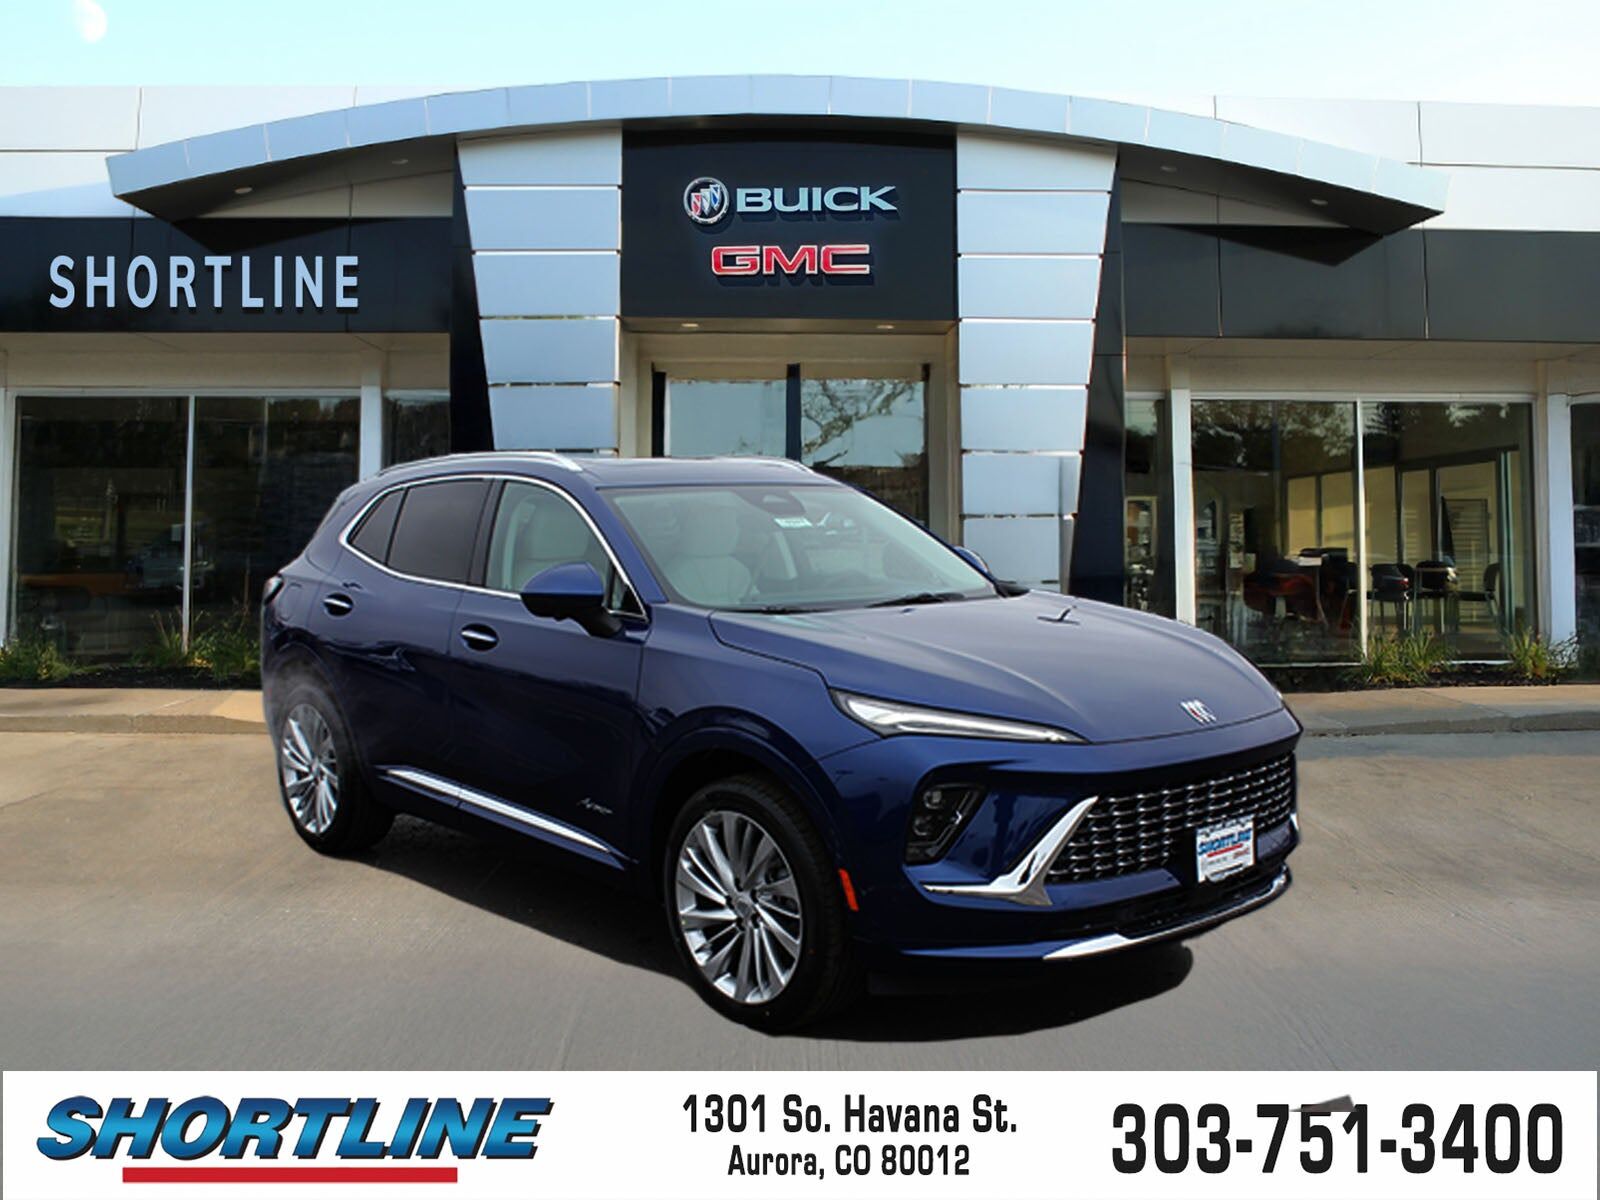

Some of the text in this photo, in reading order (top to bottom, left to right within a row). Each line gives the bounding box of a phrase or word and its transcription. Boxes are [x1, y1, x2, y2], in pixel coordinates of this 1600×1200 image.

[736, 186, 898, 212] BUICK
[711, 244, 870, 275] GMC
[49, 255, 359, 308] SHORTLINE
